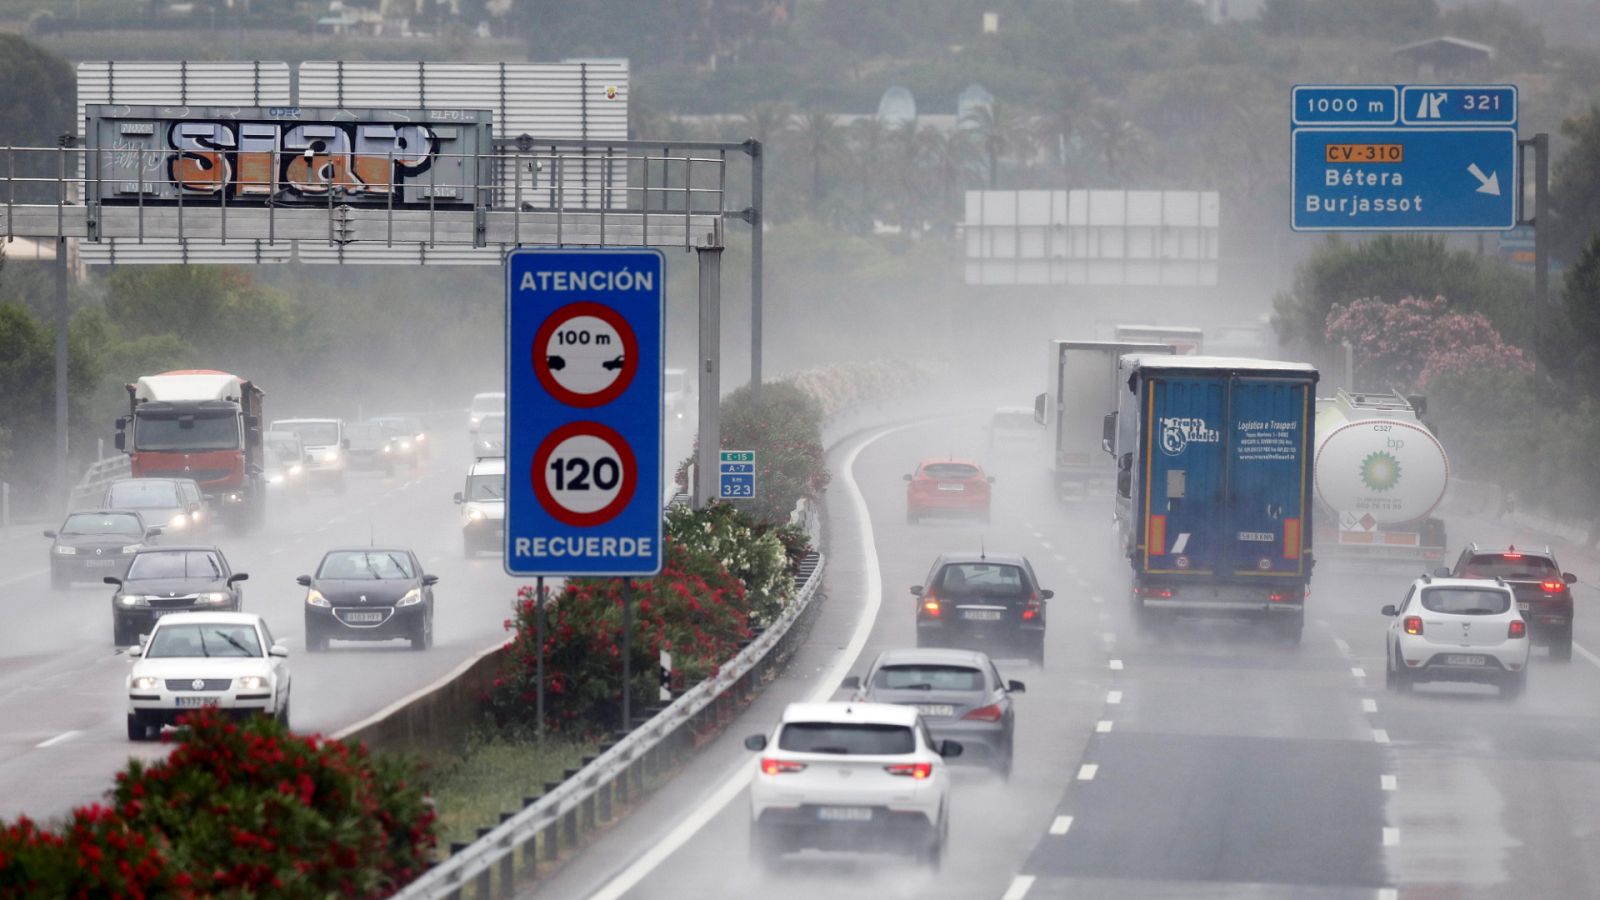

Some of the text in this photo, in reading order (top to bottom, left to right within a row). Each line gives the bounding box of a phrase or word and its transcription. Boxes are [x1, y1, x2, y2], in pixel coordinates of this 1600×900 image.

[1307, 98, 1384, 113] 1000 m
[1463, 94, 1500, 111] 321
[1328, 146, 1401, 161] CV-310
[1324, 168, 1404, 187] Bétera
[1305, 195, 1423, 217] Burjassot
[519, 266, 654, 291] ATENCIÓN
[557, 330, 611, 346] 100 m
[1237, 420, 1264, 432] Logistica
[1270, 420, 1297, 432] Trasporti
[1386, 436, 1405, 451] bp
[726, 453, 748, 461] E-15
[550, 456, 620, 491] 120
[728, 464, 746, 472] A-7
[723, 484, 751, 495] 323
[515, 536, 653, 558] RECUERDE
